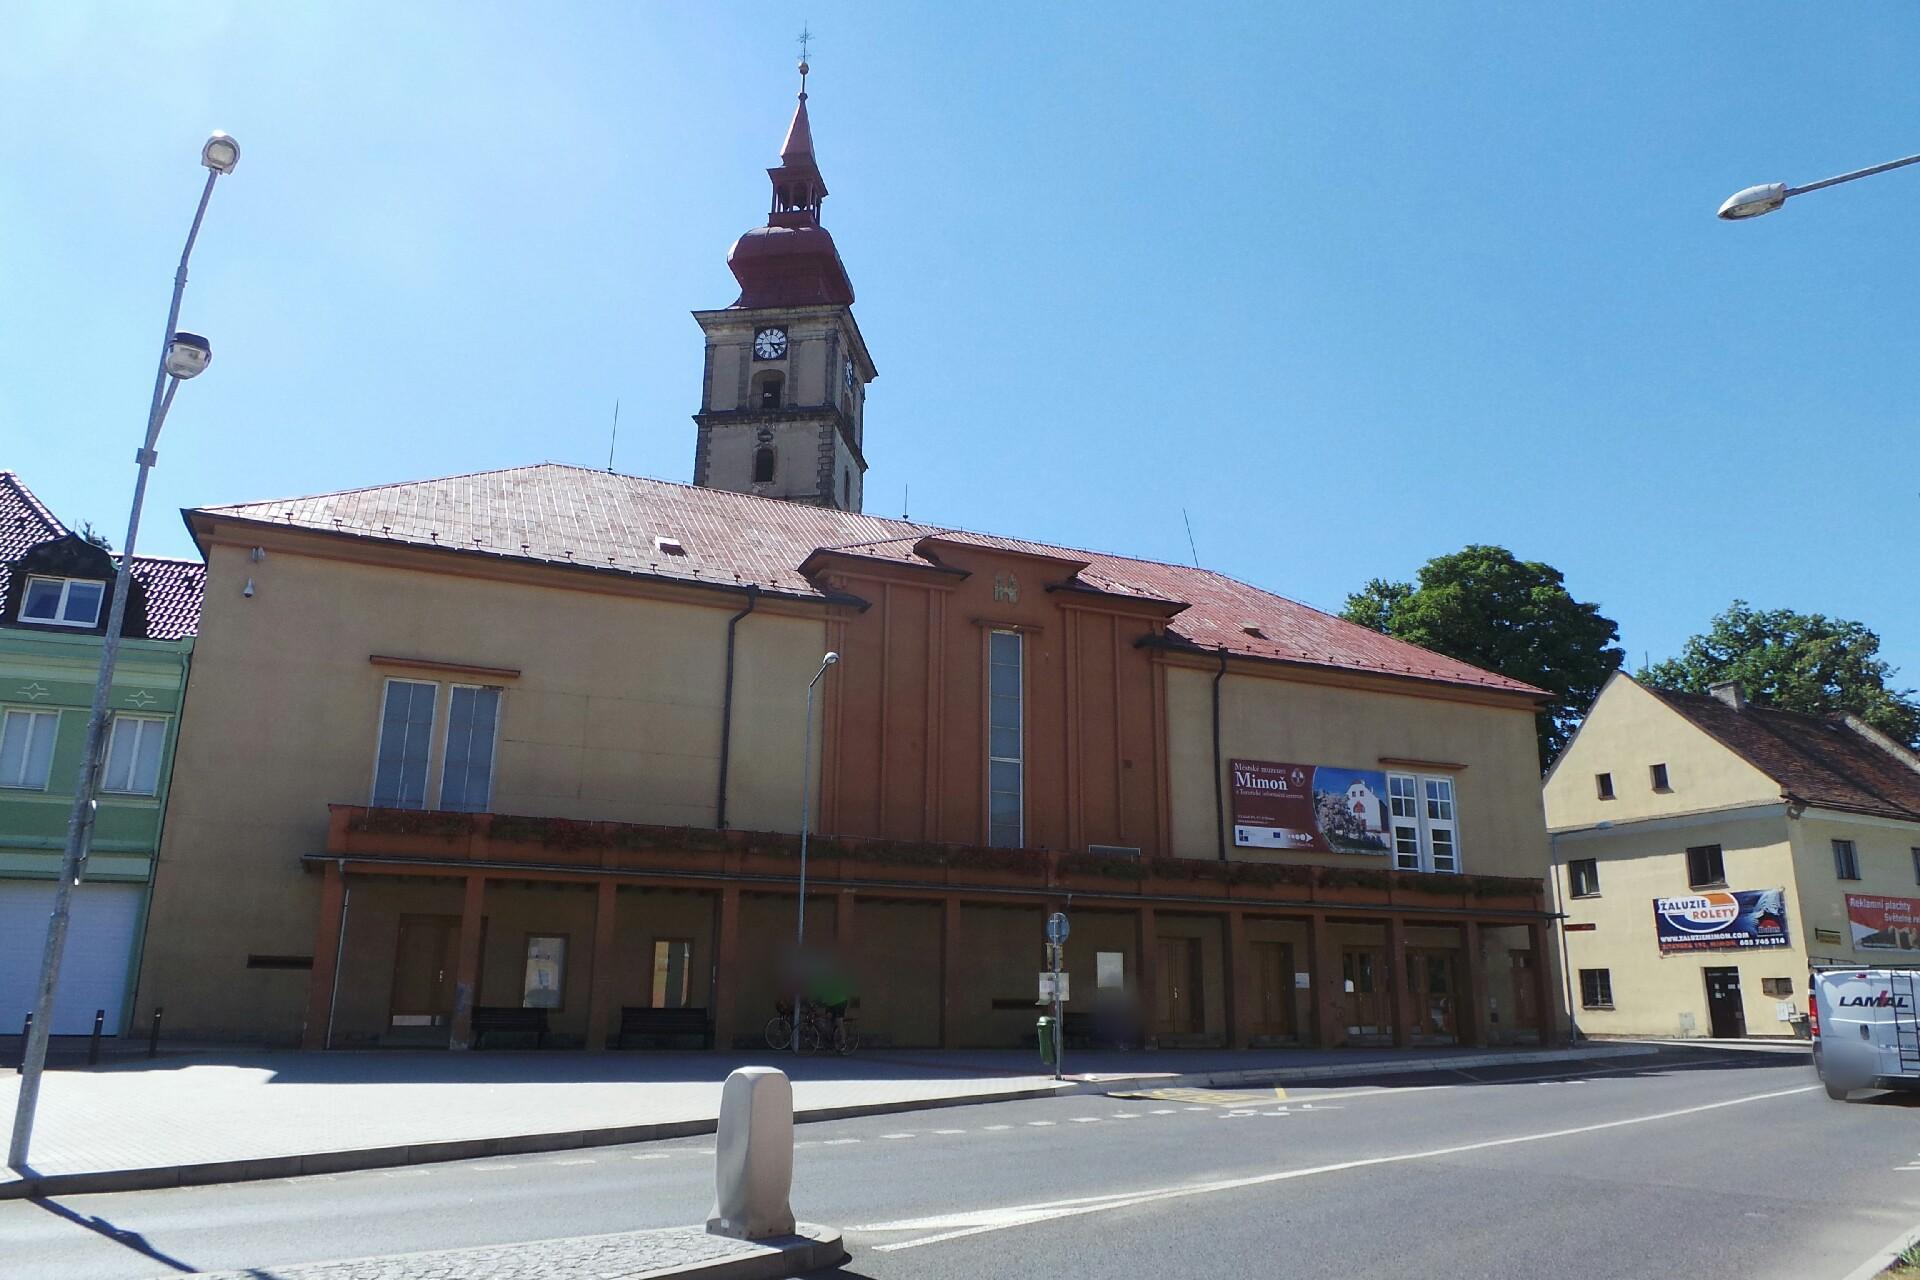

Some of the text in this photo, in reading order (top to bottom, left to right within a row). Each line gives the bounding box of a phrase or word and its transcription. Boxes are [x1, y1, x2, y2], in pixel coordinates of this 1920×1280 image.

[1234, 771, 1288, 791] Mimoň
[1660, 899, 1707, 912] ŽALUZIE
[1692, 907, 1736, 920] ROLETY
